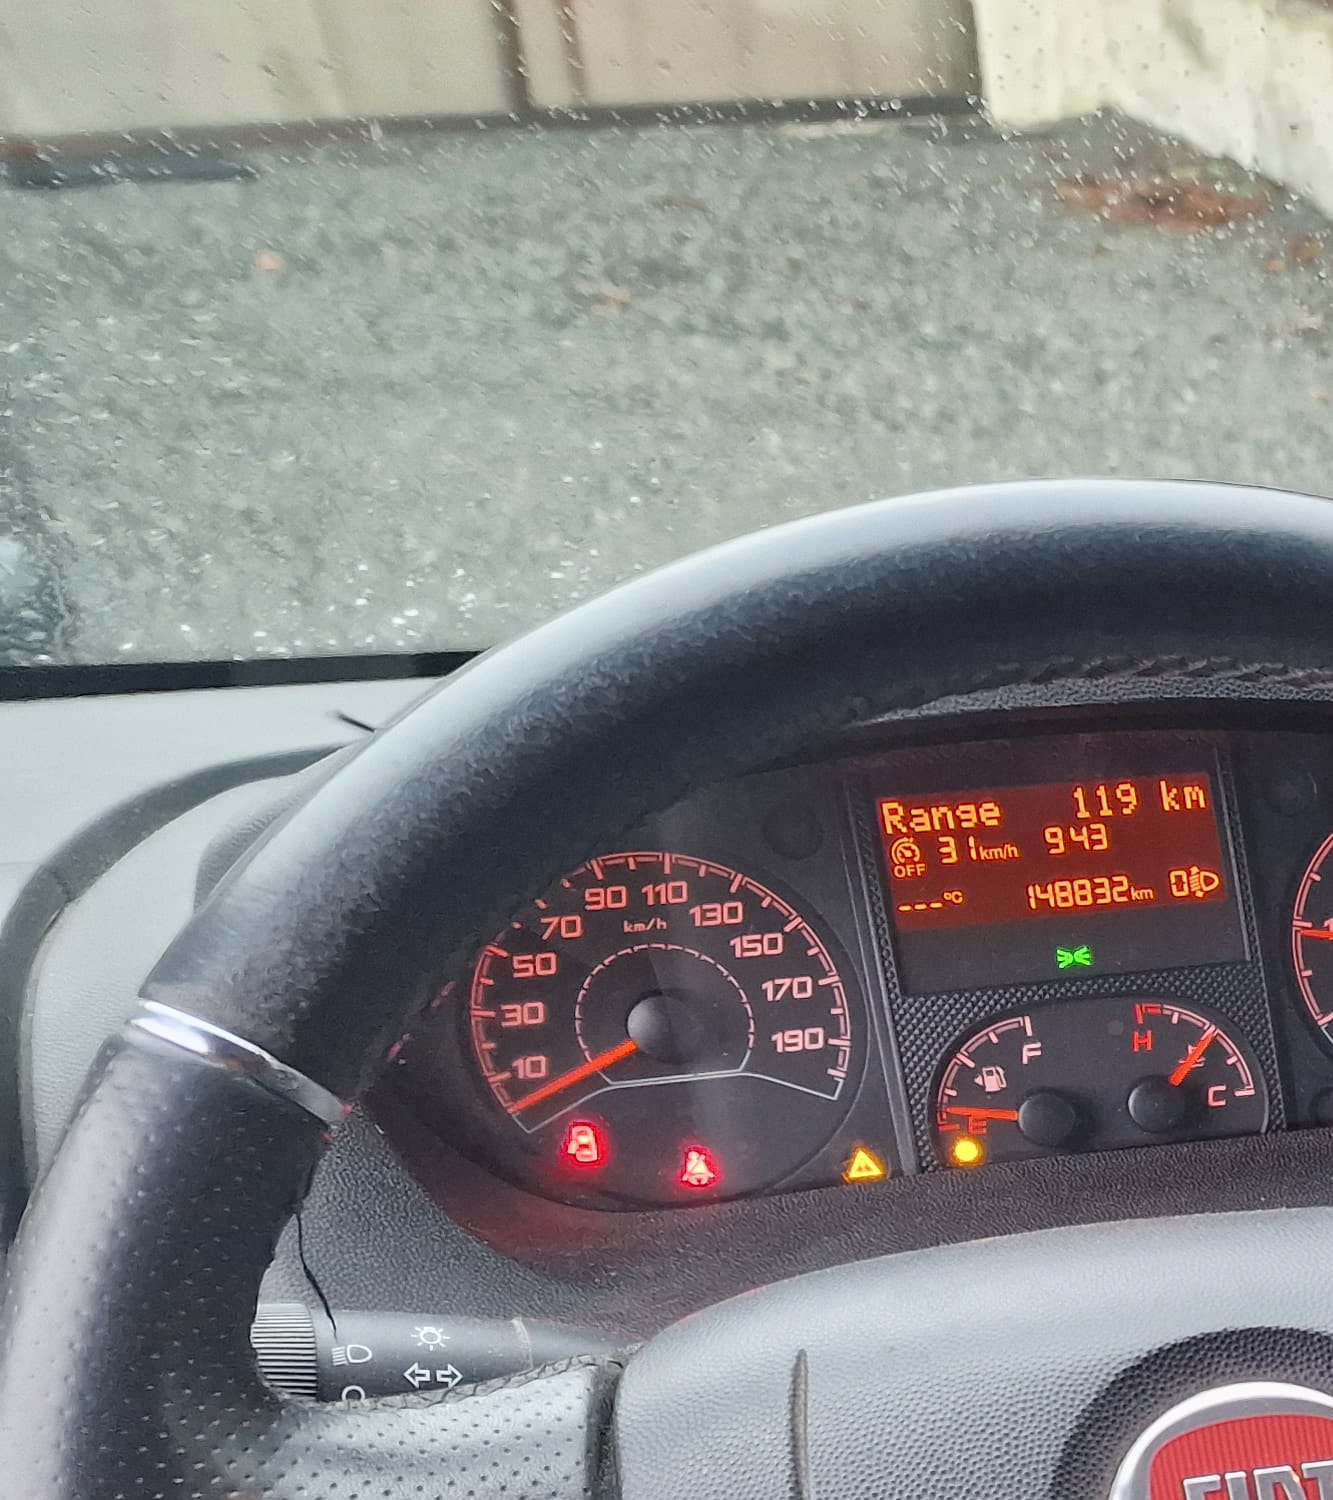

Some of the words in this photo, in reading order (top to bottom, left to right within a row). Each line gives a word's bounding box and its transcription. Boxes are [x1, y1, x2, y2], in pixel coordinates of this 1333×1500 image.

[881, 801, 1000, 834] Range
[1073, 782, 1137, 818] 119
[1159, 780, 1206, 811] km
[979, 843, 1018, 861] km/h
[1044, 823, 1108, 854] 943
[893, 863, 925, 878] OFF
[584, 885, 627, 911] 90
[641, 880, 688, 905] 110
[1027, 875, 1128, 909] 148832
[1130, 886, 1153, 902] km
[623, 917, 667, 933] km/h
[689, 902, 743, 927] 130
[540, 915, 583, 941] 70
[729, 932, 783, 958] 150
[512, 953, 557, 977] 50
[761, 976, 812, 1001] 170
[500, 1002, 544, 1027] 30
[771, 1027, 824, 1053] 190
[1133, 1031, 1152, 1051] H
[1022, 1042, 1042, 1064] F
[512, 1056, 546, 1079] 10
[1208, 1085, 1226, 1107] C
